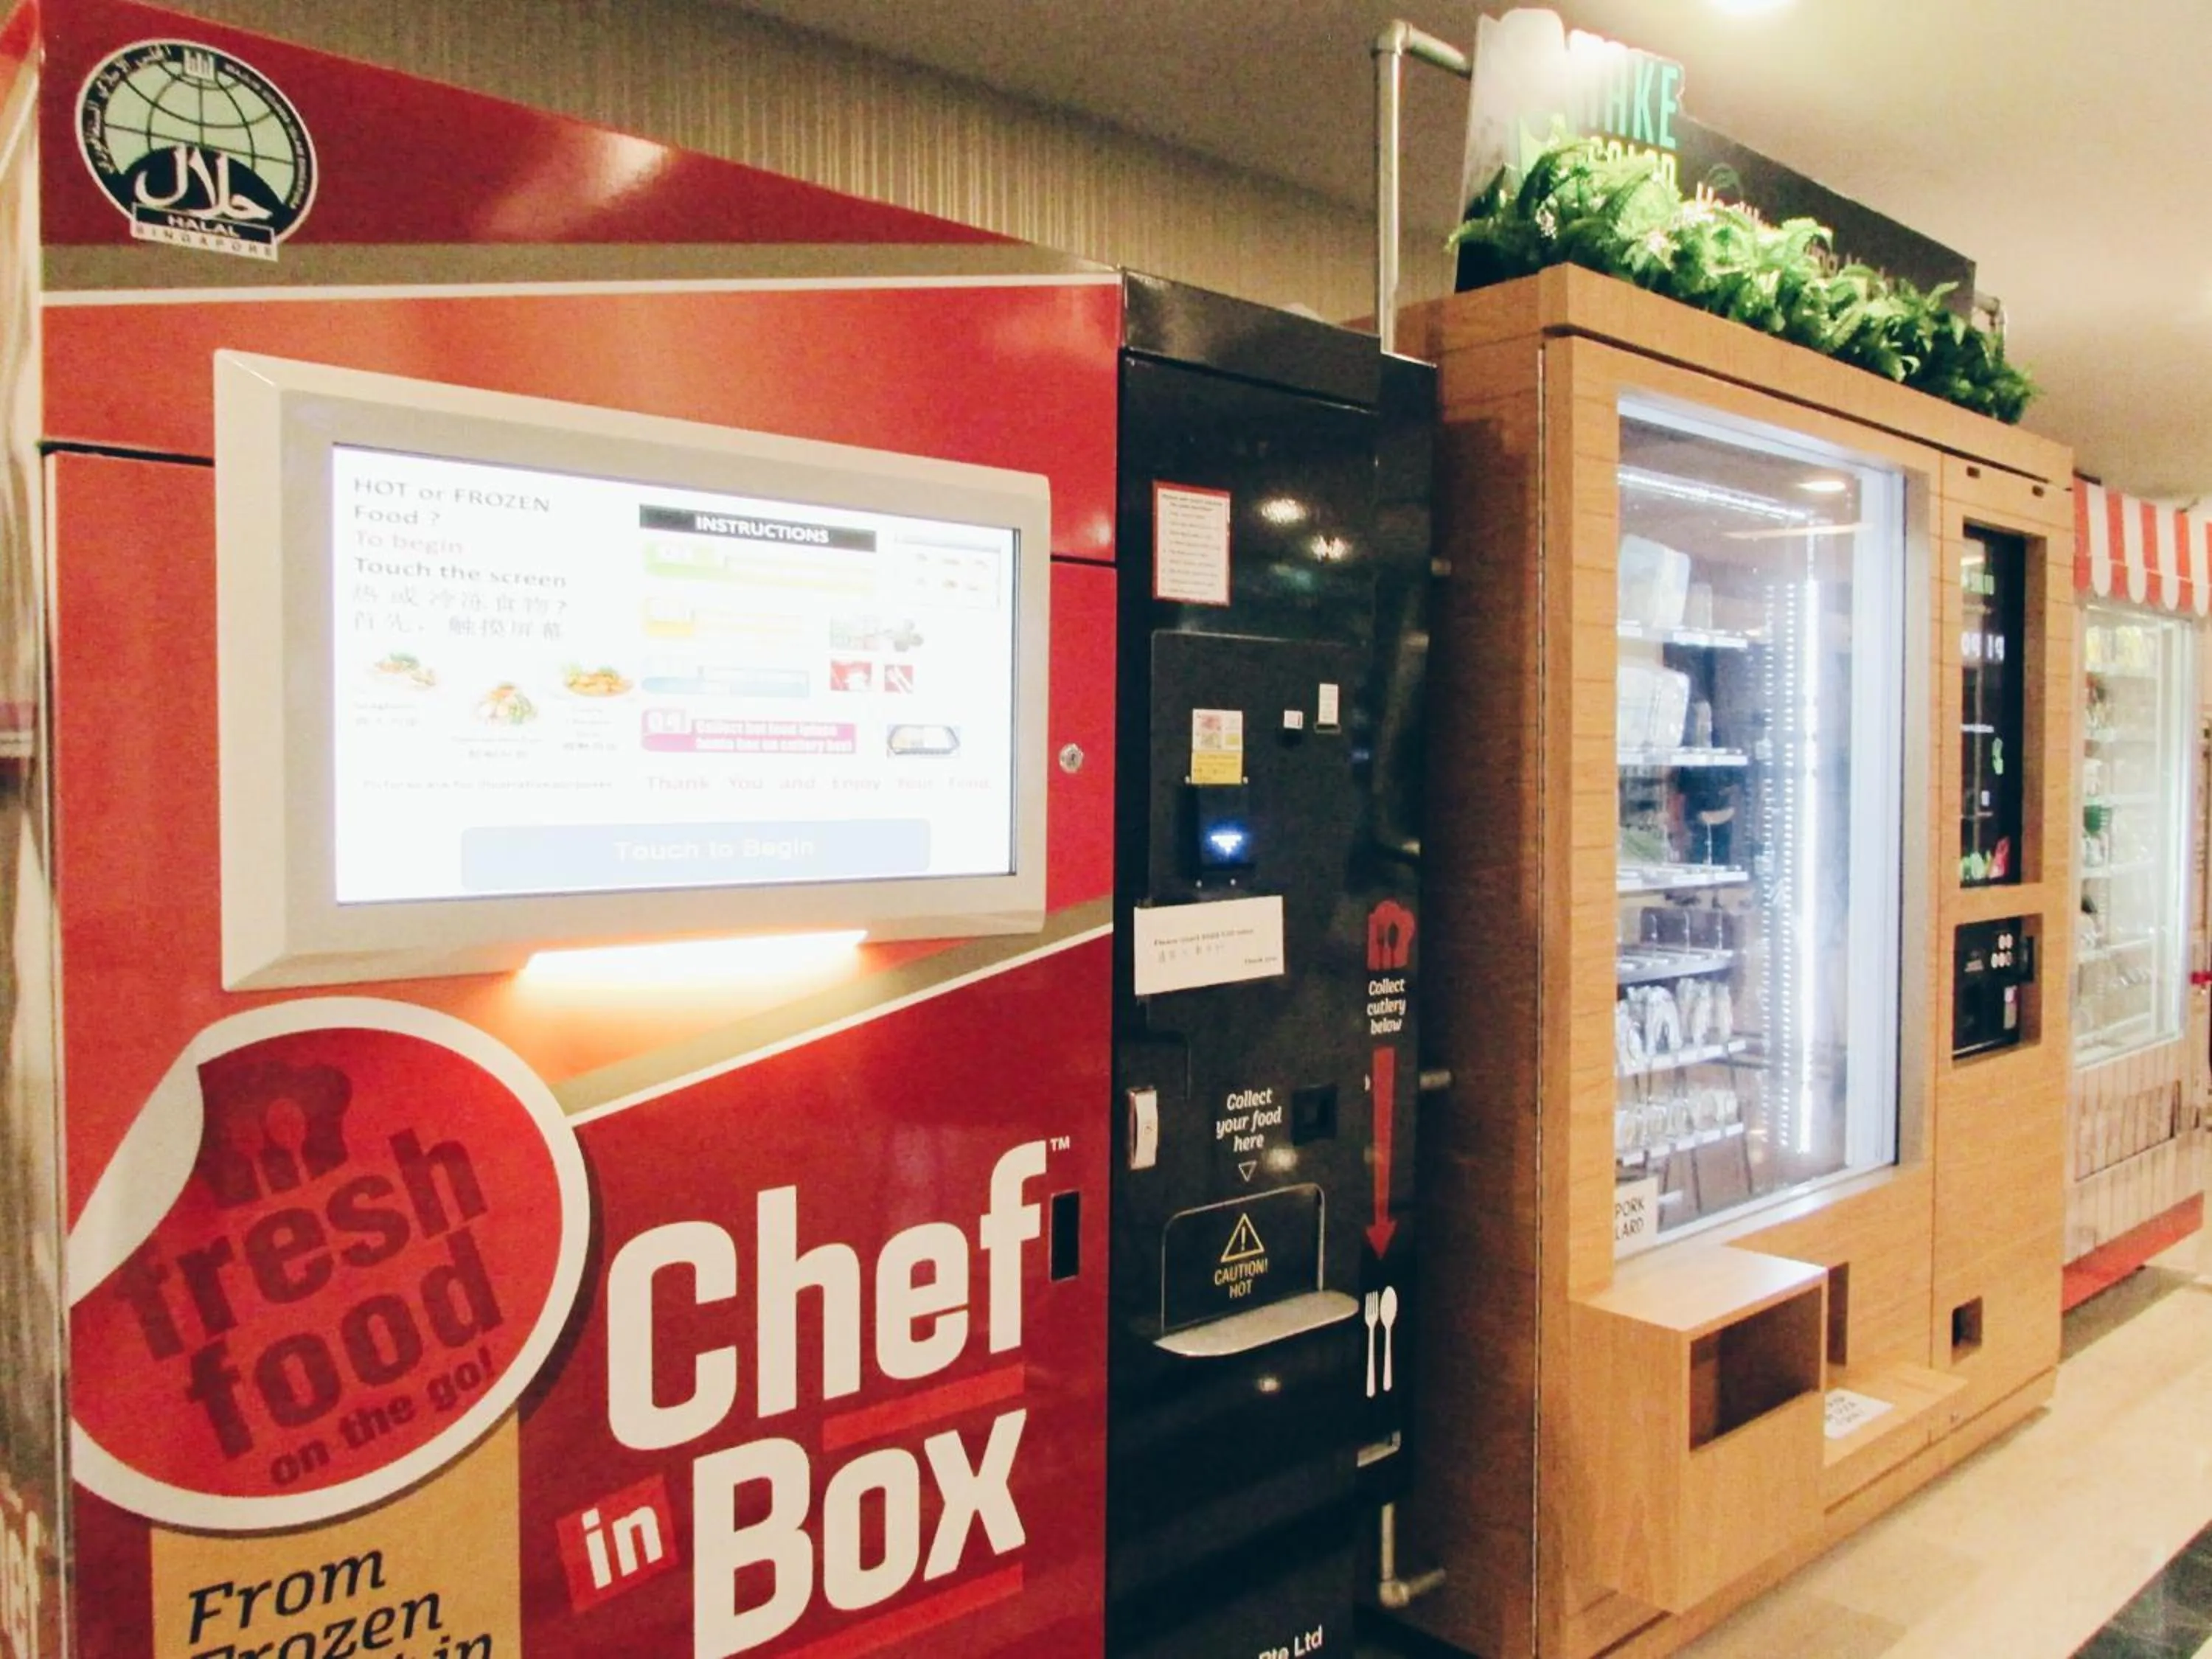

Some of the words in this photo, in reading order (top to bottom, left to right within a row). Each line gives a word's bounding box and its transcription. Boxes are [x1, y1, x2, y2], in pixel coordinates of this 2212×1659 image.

[135, 223, 273, 257] SINGAPORE
[167, 215, 240, 237] HALAL
[354, 476, 408, 498] HOT
[418, 487, 445, 502] or
[453, 487, 551, 514] FROZEN
[354, 504, 419, 526] Food
[695, 515, 830, 544] INSTRUCTIONS
[354, 528, 383, 547] To
[392, 532, 464, 557] begin
[354, 557, 431, 579] Touch
[439, 563, 481, 582] the
[490, 571, 567, 588] screen
[613, 840, 699, 863] Touch
[709, 841, 734, 860] to
[743, 837, 815, 861] Begin
[1368, 978, 1405, 995] Collect
[1366, 998, 1407, 1016] cutlery
[1370, 1018, 1402, 1035] below
[1226, 1088, 1273, 1111] Collect
[1216, 1116, 1250, 1140] your
[1250, 1105, 1282, 1133] food
[1233, 1133, 1265, 1152] here
[114, 1127, 488, 1363] fresh
[608, 1140, 1046, 1451] Chef
[1229, 1279, 1252, 1298] HOT
[186, 1227, 504, 1461] food
[270, 1440, 330, 1487] on
[339, 1396, 417, 1450] the
[426, 1346, 495, 1413] go!
[581, 1505, 664, 1590] in
[692, 1408, 1027, 1659] Box
[188, 1550, 386, 1645] From
[190, 1592, 442, 1659] ozen
[1294, 1623, 1324, 1658] Ltd
